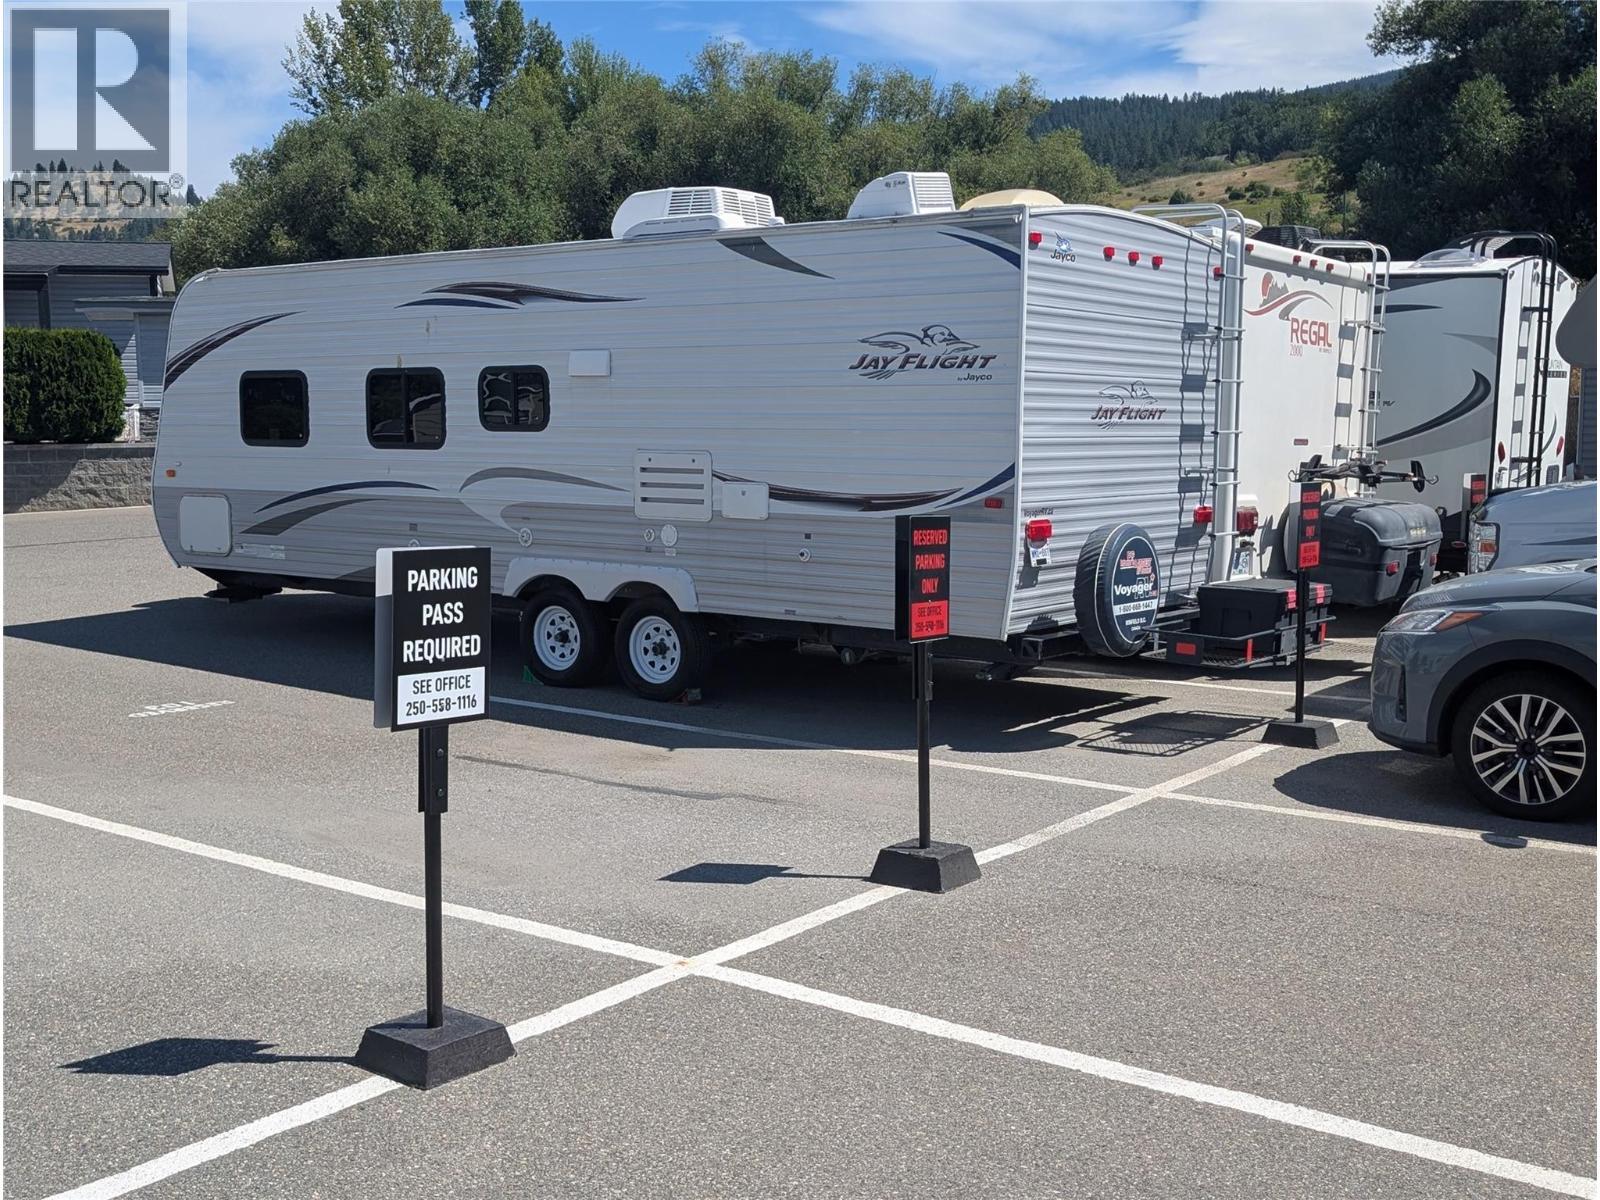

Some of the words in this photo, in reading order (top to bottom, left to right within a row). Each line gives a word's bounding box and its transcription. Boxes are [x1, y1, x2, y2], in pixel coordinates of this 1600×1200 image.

[1050, 249, 1076, 263] Jayco
[1290, 317, 1332, 348] REGAL
[848, 353, 899, 370] JAY
[898, 353, 997, 370] FLIGHT
[963, 373, 993, 382] Jayco
[1091, 405, 1119, 420] JAY
[1118, 406, 1167, 420] FLIGHT
[913, 529, 948, 546] RESERVED
[915, 554, 945, 571] PARKING
[407, 566, 478, 592] PARKING
[921, 578, 939, 594] ONLY
[1114, 582, 1154, 597] Voyager
[422, 601, 464, 626] PASS
[403, 634, 481, 664] REQUIRED
[412, 678, 432, 695] SEE
[435, 674, 471, 692] OFFICE
[406, 694, 477, 716] 250-558-1116
